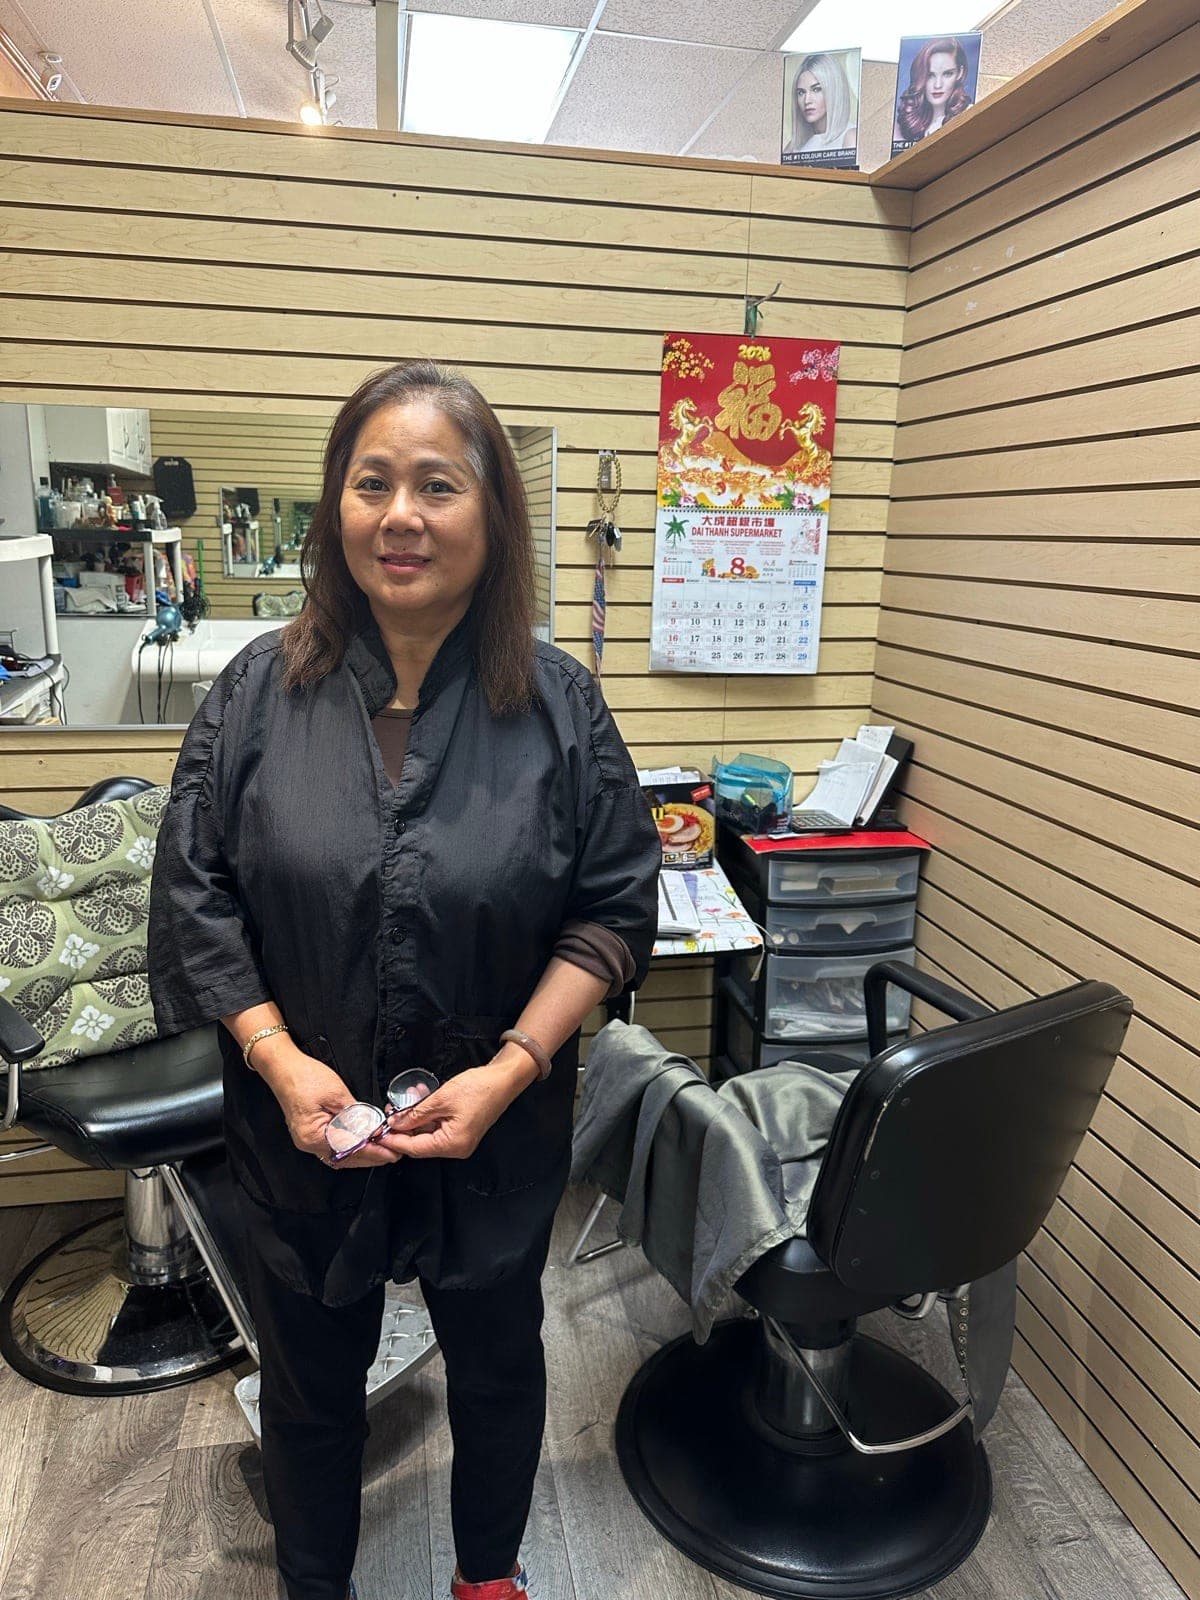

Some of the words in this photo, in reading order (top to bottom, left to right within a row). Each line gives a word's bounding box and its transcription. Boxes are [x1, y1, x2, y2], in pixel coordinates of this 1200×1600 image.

[738, 344, 772, 362] 2026
[714, 361, 783, 442] 福
[692, 527, 704, 536] DAI
[704, 527, 729, 537] THANH
[730, 528, 782, 538] SUPERMARKET
[730, 557, 745, 576] 8
